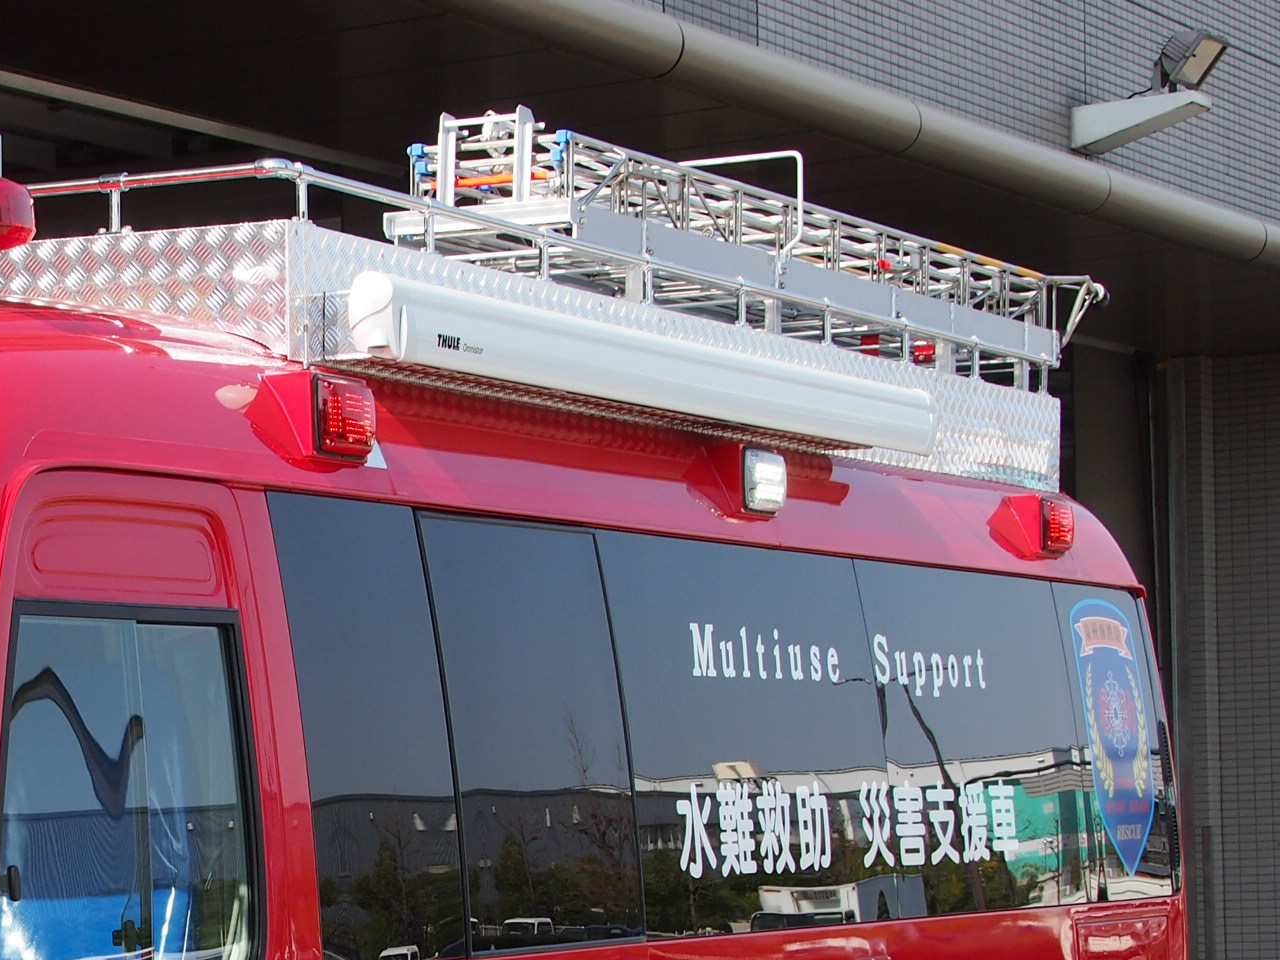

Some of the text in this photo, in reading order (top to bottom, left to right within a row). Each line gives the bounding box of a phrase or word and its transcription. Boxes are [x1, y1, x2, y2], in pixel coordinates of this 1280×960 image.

[437, 333, 461, 351] THULE
[689, 622, 986, 697] Multiuse Support
[676, 780, 1020, 879] 水難救助 災害支援車
